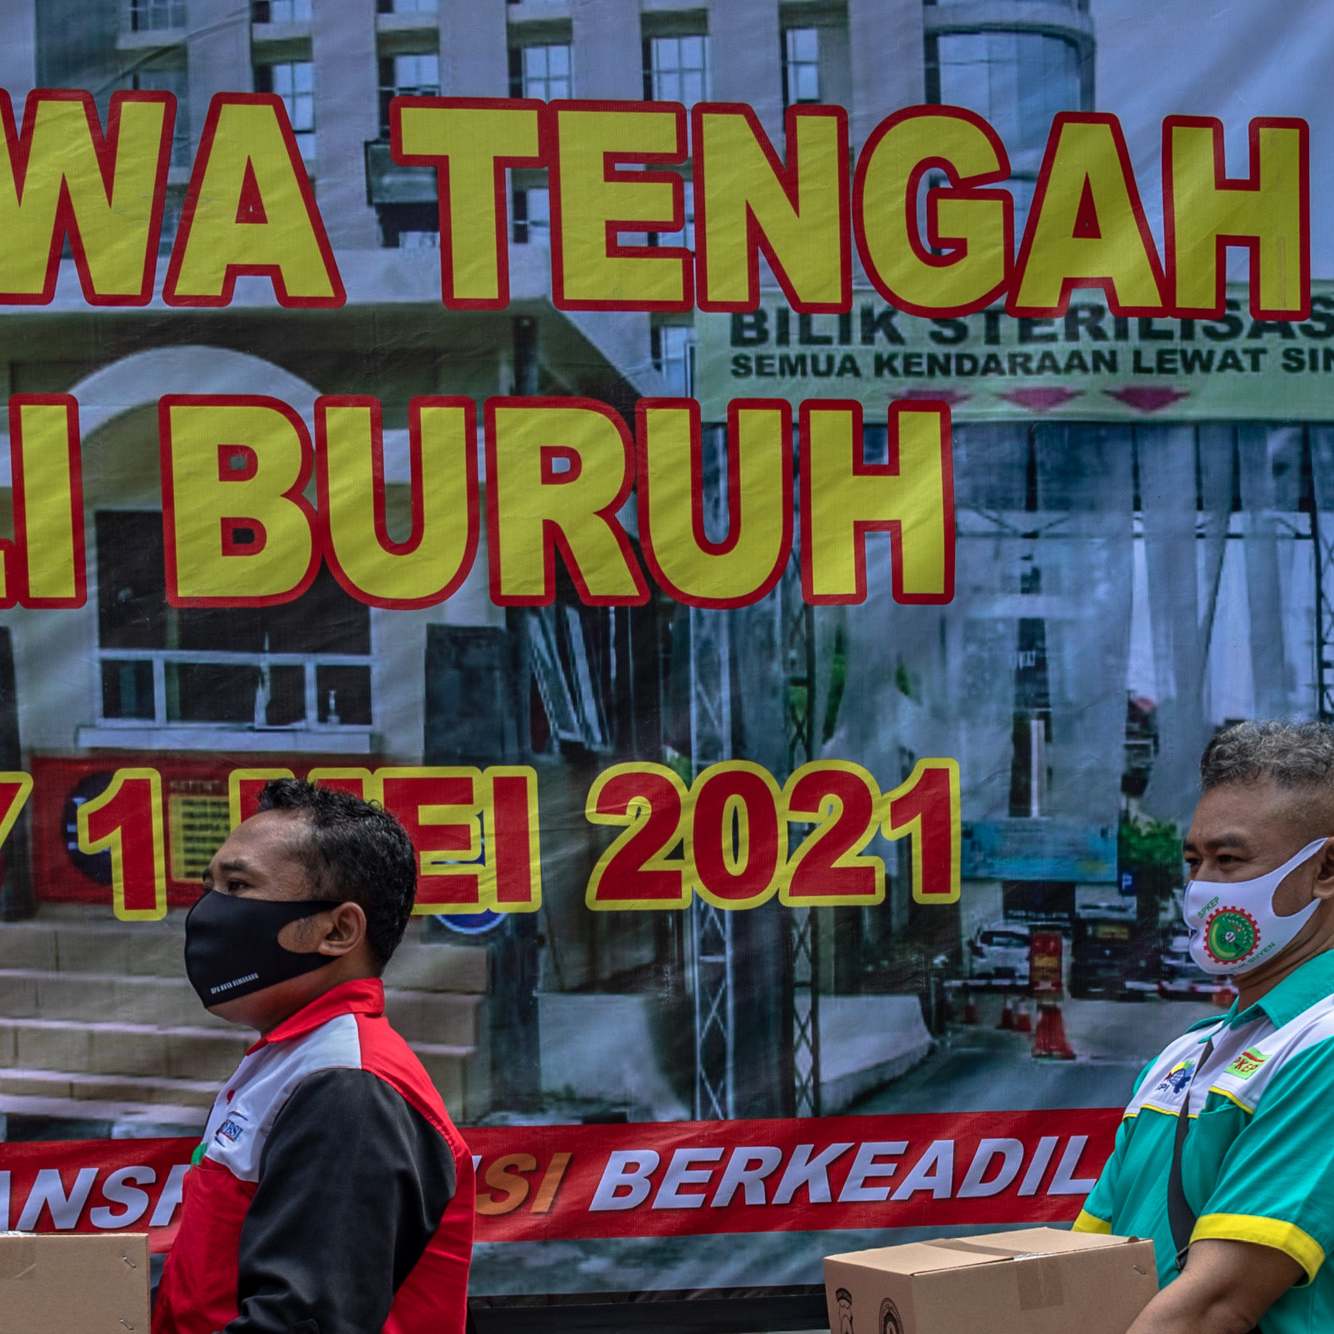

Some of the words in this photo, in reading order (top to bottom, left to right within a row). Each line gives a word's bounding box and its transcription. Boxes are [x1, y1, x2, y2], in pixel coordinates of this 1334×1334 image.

[389, 97, 1311, 320] TENGAH
[730, 302, 905, 347] BILIK
[730, 352, 862, 378] SEMUA
[874, 349, 1117, 378] KENDARAAN
[1132, 348, 1267, 375] LEWAT
[159, 394, 956, 606] BURUH
[77, 767, 168, 921] 1
[584, 757, 961, 912] 2021
[1197, 896, 1219, 918] SPKEP
[589, 1135, 1098, 1213] BERKEADIL
